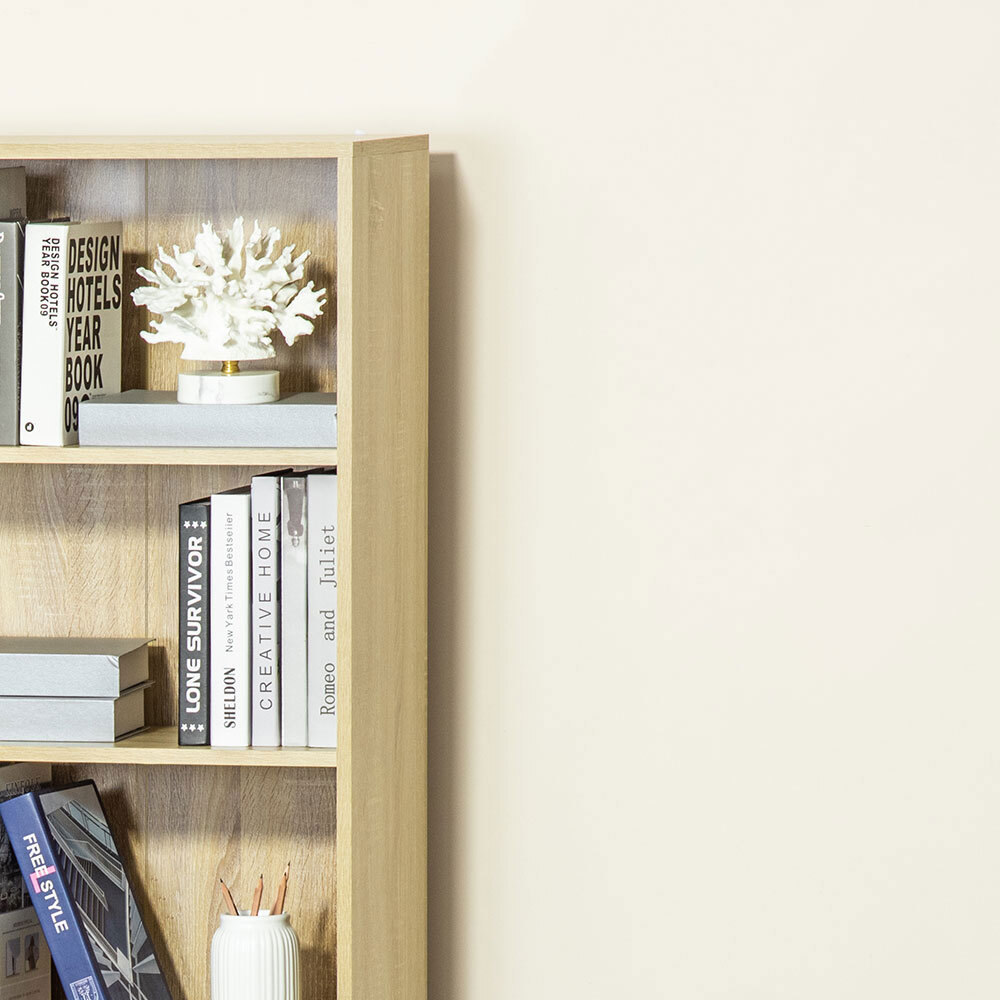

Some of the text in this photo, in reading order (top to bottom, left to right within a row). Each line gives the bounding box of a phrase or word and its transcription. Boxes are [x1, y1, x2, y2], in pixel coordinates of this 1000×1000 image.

[41, 237, 51, 267] YEAR
[68, 234, 121, 274] DESIGN
[48, 238, 60, 328] DESIGN HOTELS
[67, 273, 122, 313] HOTELS
[66, 314, 102, 353] YEAR
[65, 353, 104, 393] BOOK
[224, 569, 234, 601] Times
[185, 536, 203, 713] LONE SURVIVOR
[257, 512, 273, 711] CREATIVE HOME
[319, 525, 337, 716] Romeo and Juliet
[225, 625, 234, 653] New
[223, 668, 236, 729] SHELDON
[22, 832, 69, 935] FREE STYLE
